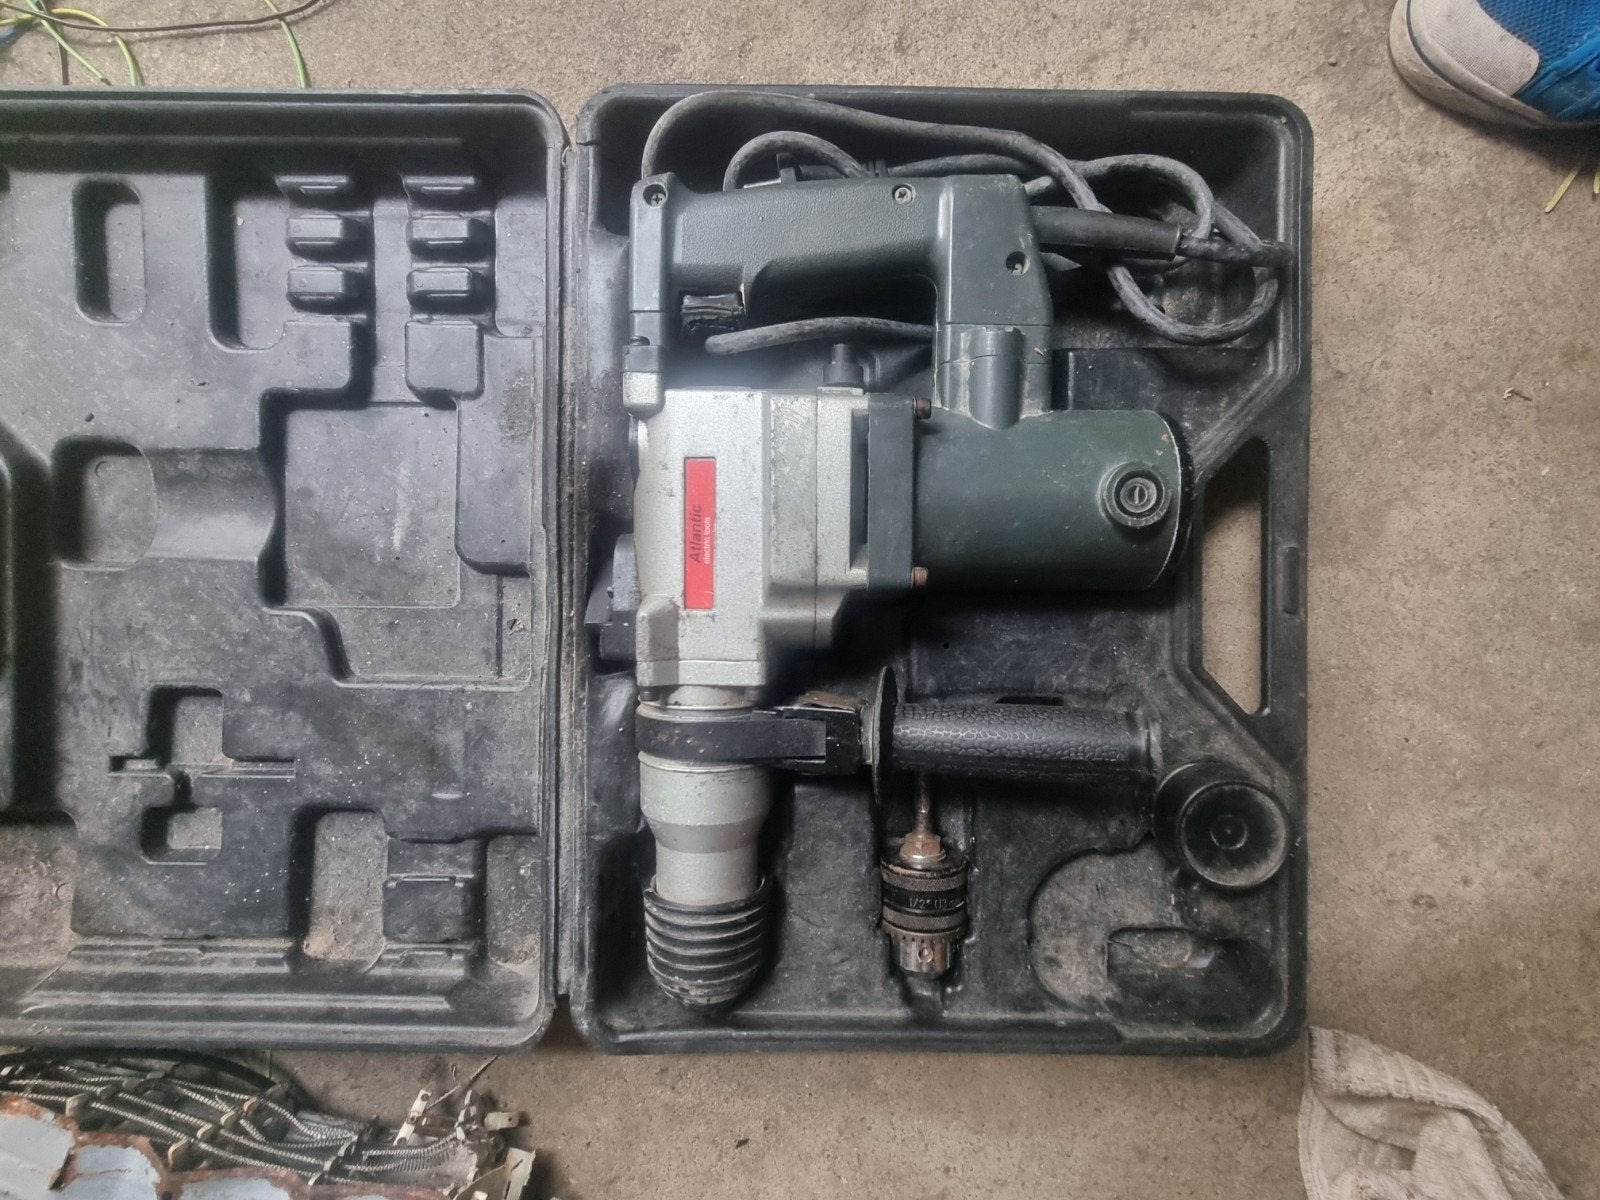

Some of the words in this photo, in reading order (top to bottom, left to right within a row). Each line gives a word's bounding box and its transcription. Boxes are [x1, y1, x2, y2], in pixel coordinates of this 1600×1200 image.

[689, 504, 702, 563] Atlantic
[703, 516, 711, 536] tools
[703, 537, 711, 565] electric
